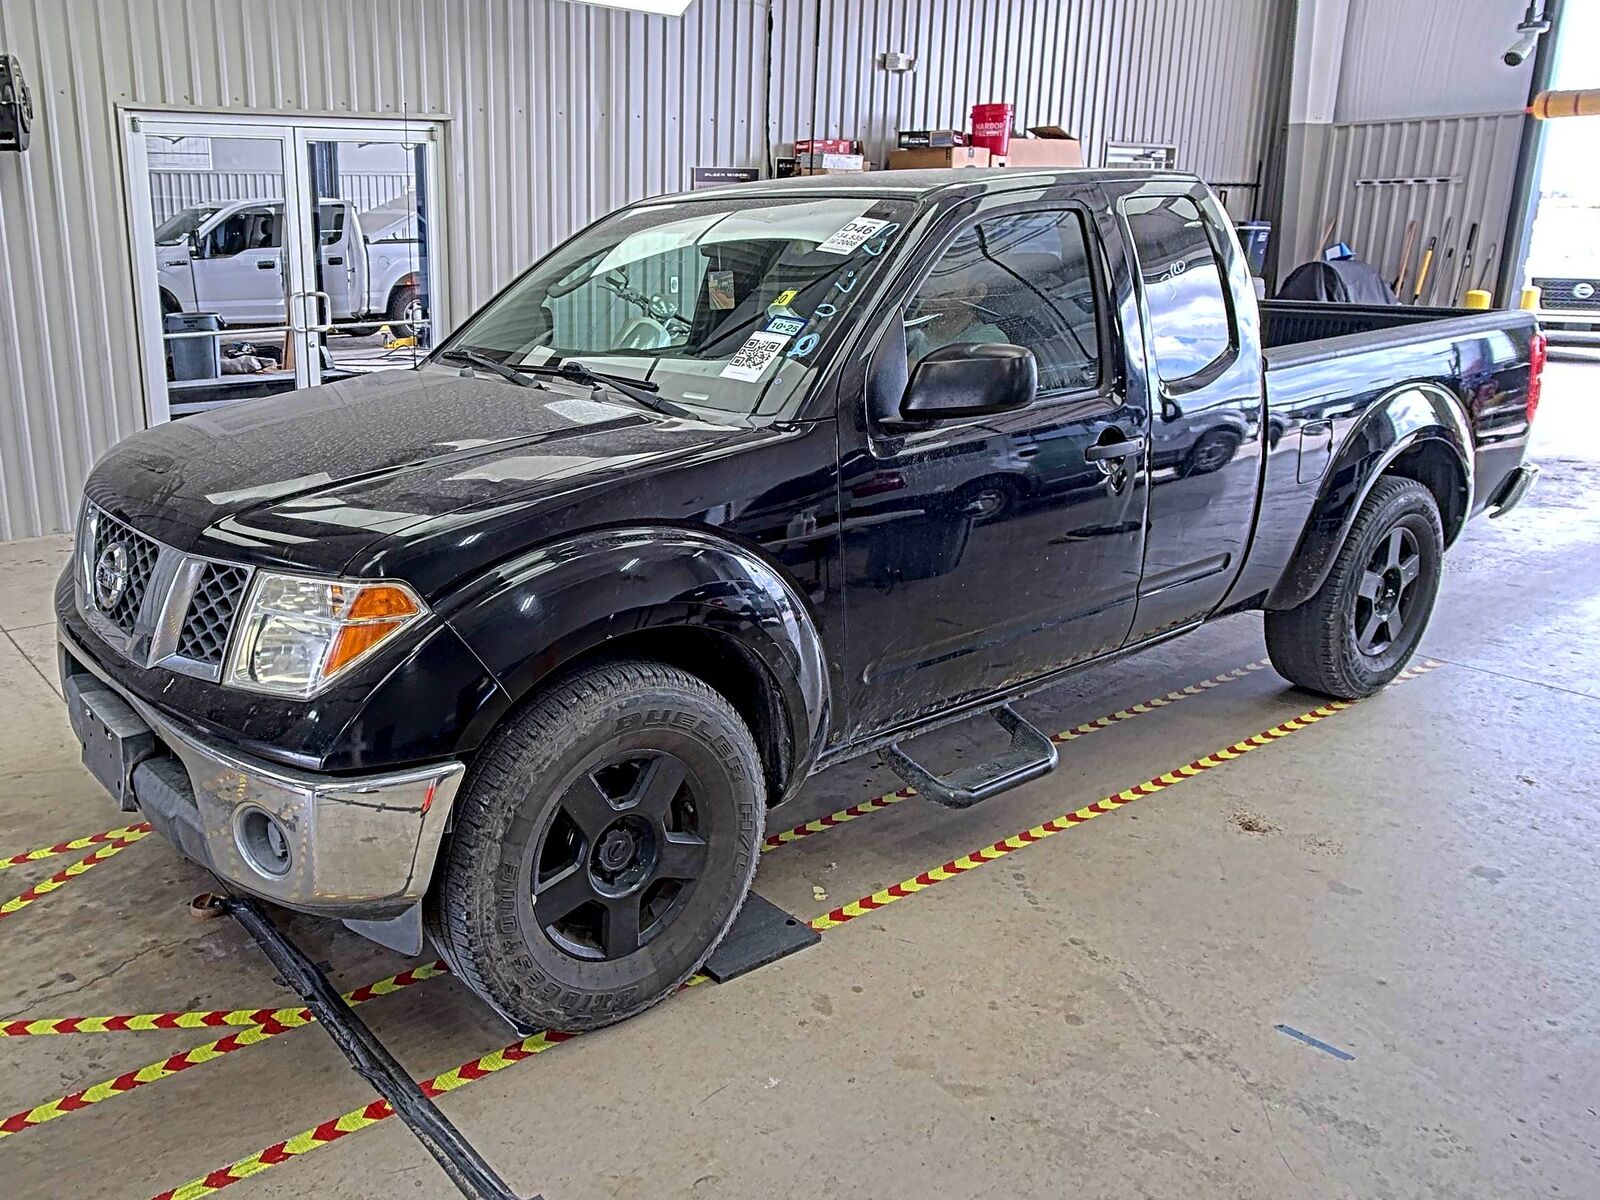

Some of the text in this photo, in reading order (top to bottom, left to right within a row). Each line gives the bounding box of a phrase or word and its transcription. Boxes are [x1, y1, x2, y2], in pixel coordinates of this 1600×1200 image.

[975, 122, 1004, 130] HARBOR
[842, 223, 876, 235] D46
[613, 709, 746, 783] DUELER
